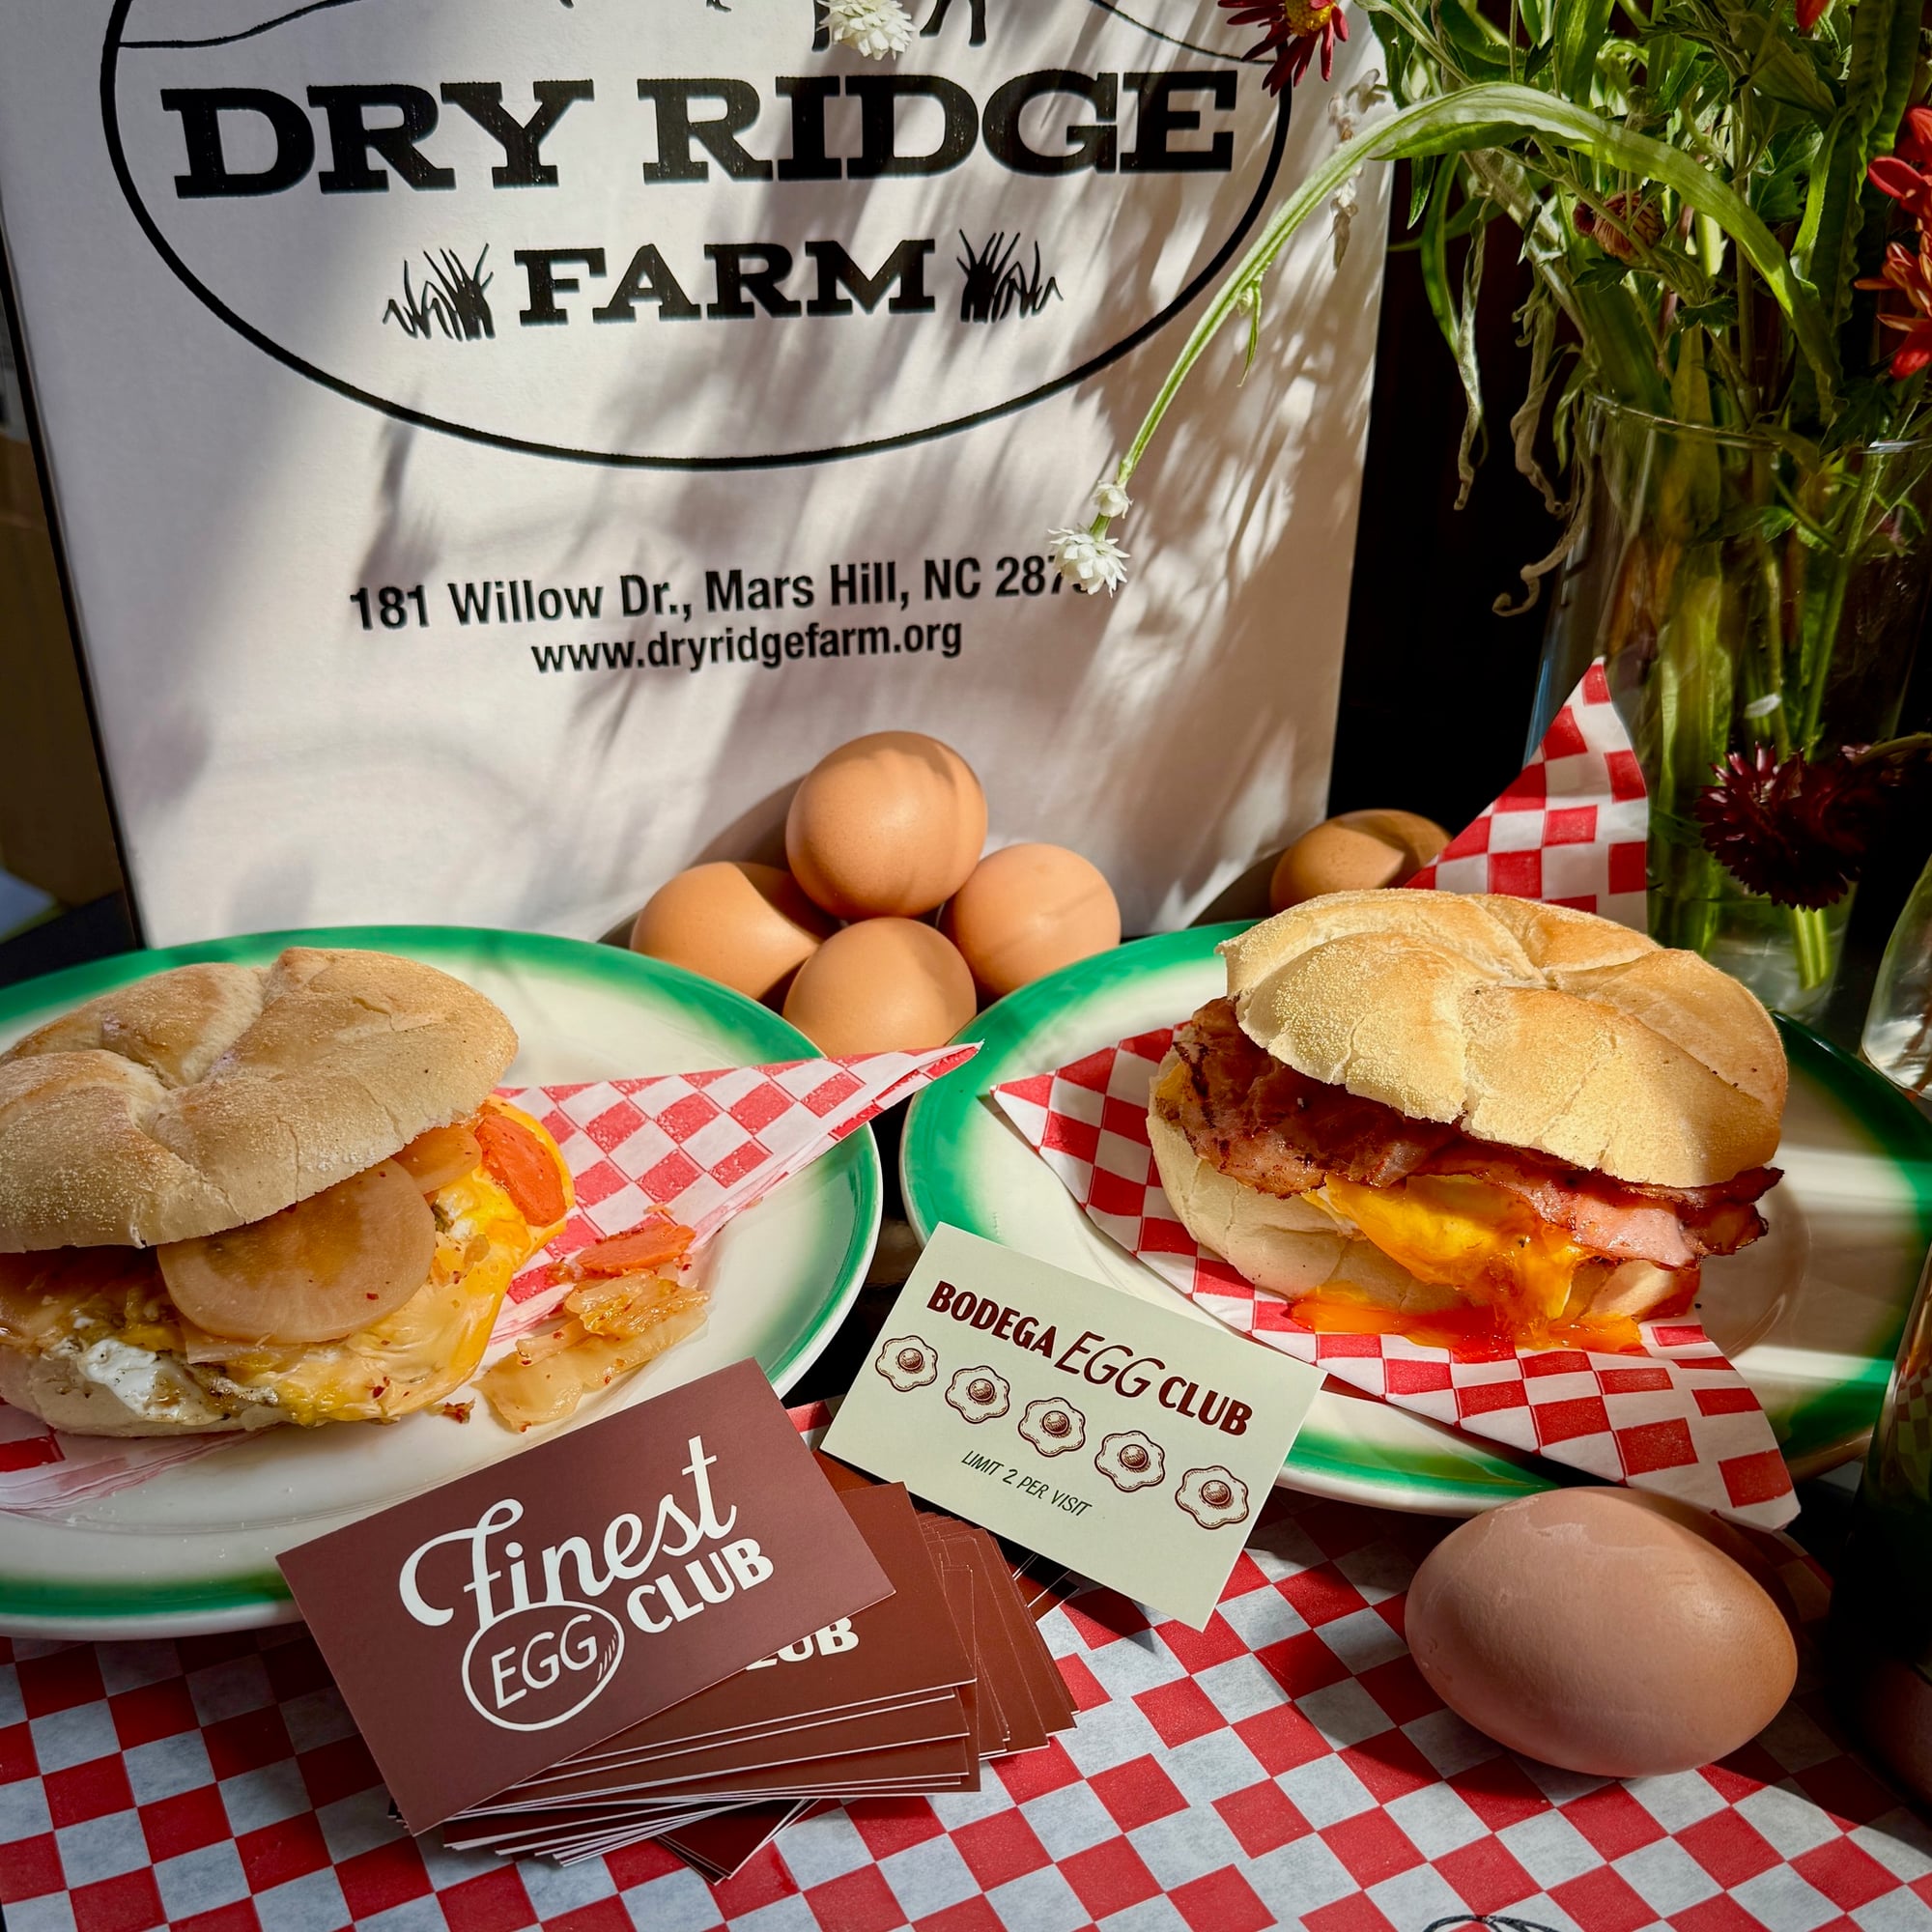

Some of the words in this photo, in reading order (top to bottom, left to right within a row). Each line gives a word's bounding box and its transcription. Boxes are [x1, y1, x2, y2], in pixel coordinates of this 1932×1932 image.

[159, 77, 595, 199] DRY
[637, 70, 1237, 184] RIDGE
[513, 238, 936, 326] FARM
[349, 582, 430, 630] 181
[447, 579, 604, 625] Willow
[619, 573, 694, 621] Dr.,
[705, 568, 815, 611] Mars
[829, 558, 910, 611] Hill,
[924, 556, 980, 600] NC
[995, 554, 1094, 597] 287
[530, 619, 963, 674] www.dryridgefarm.org
[926, 1280, 1057, 1359] BODEGA
[1054, 1330, 1166, 1398] EGG
[1158, 1376, 1253, 1436] CLUB
[961, 1450, 1005, 1476] LIMIT
[1002, 1468, 1018, 1485] 2
[1016, 1476, 1049, 1499] PER
[1051, 1490, 1093, 1517] VISIT
[398, 1435, 738, 1631] Finest
[490, 1613, 599, 1710] EGG
[626, 1537, 775, 1634] CLUB
[745, 1617, 859, 1671] UB
